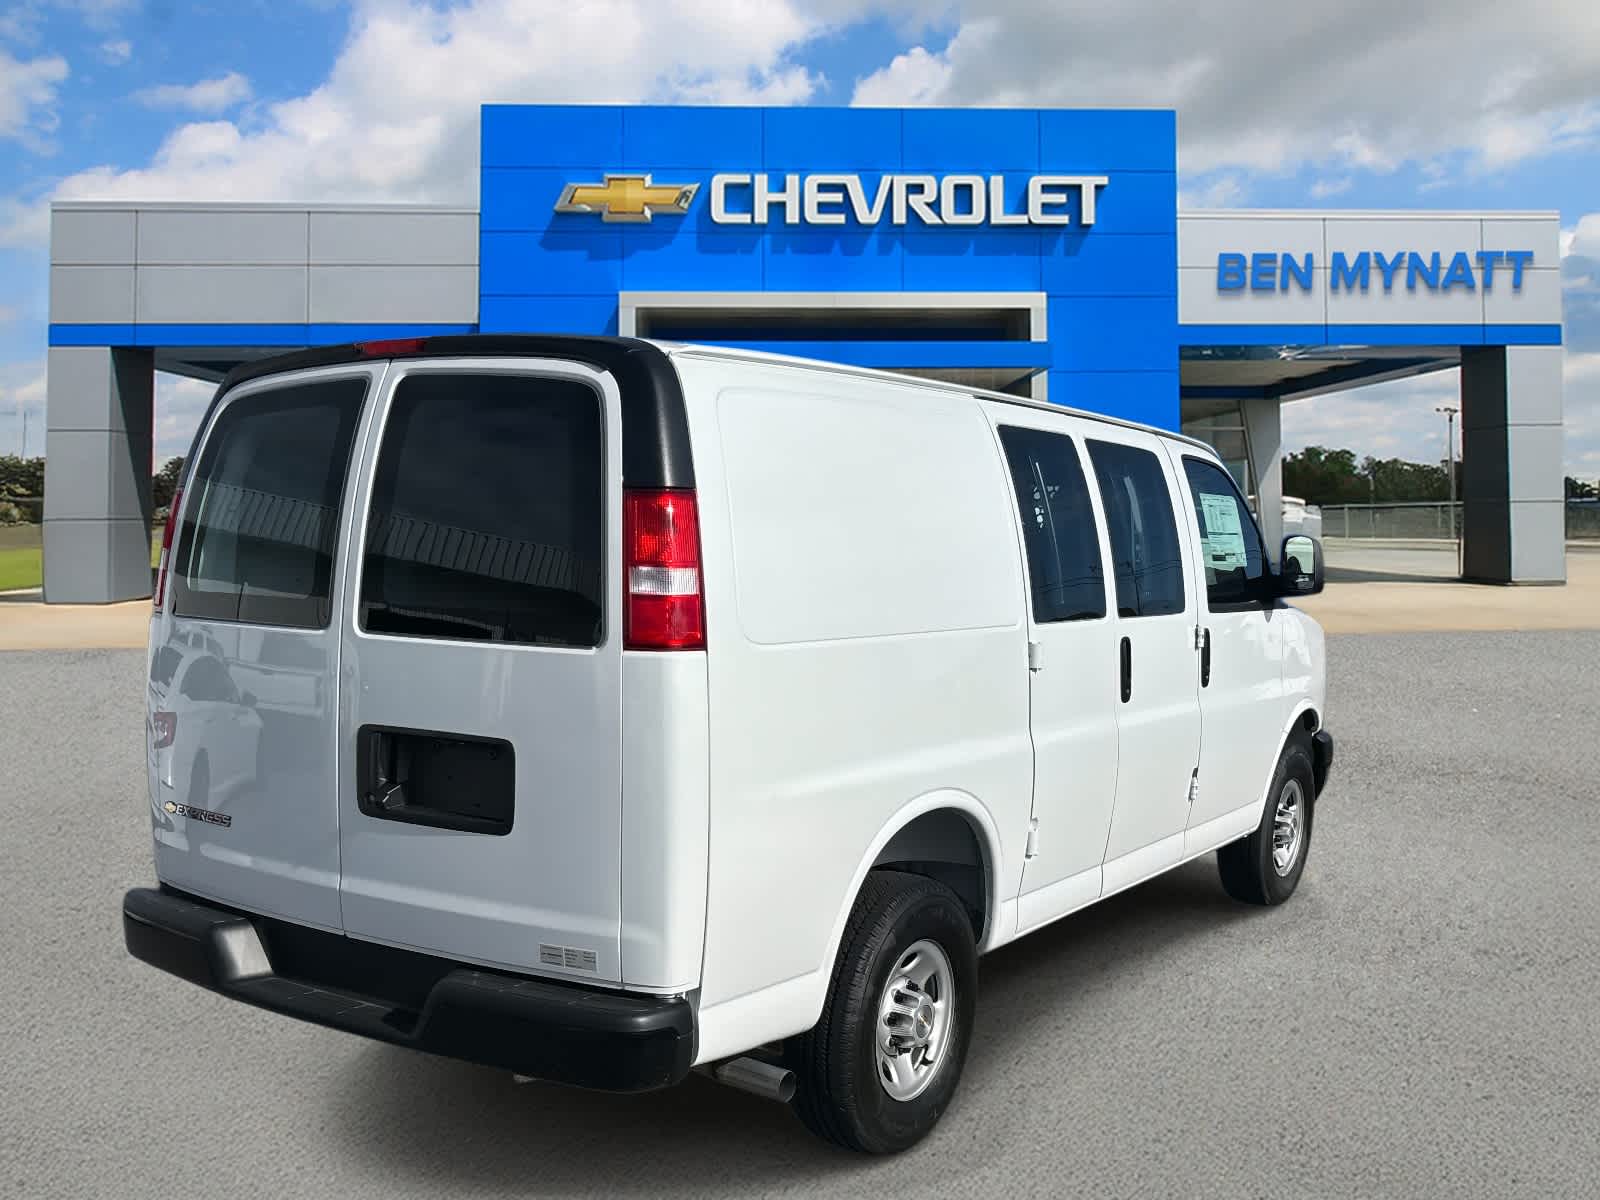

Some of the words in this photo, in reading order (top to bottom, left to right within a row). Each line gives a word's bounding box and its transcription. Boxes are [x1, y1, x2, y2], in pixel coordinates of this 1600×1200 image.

[711, 174, 1109, 225] CHEVROLET
[1217, 252, 1313, 291] BEN
[1331, 250, 1534, 293] MYNATT
